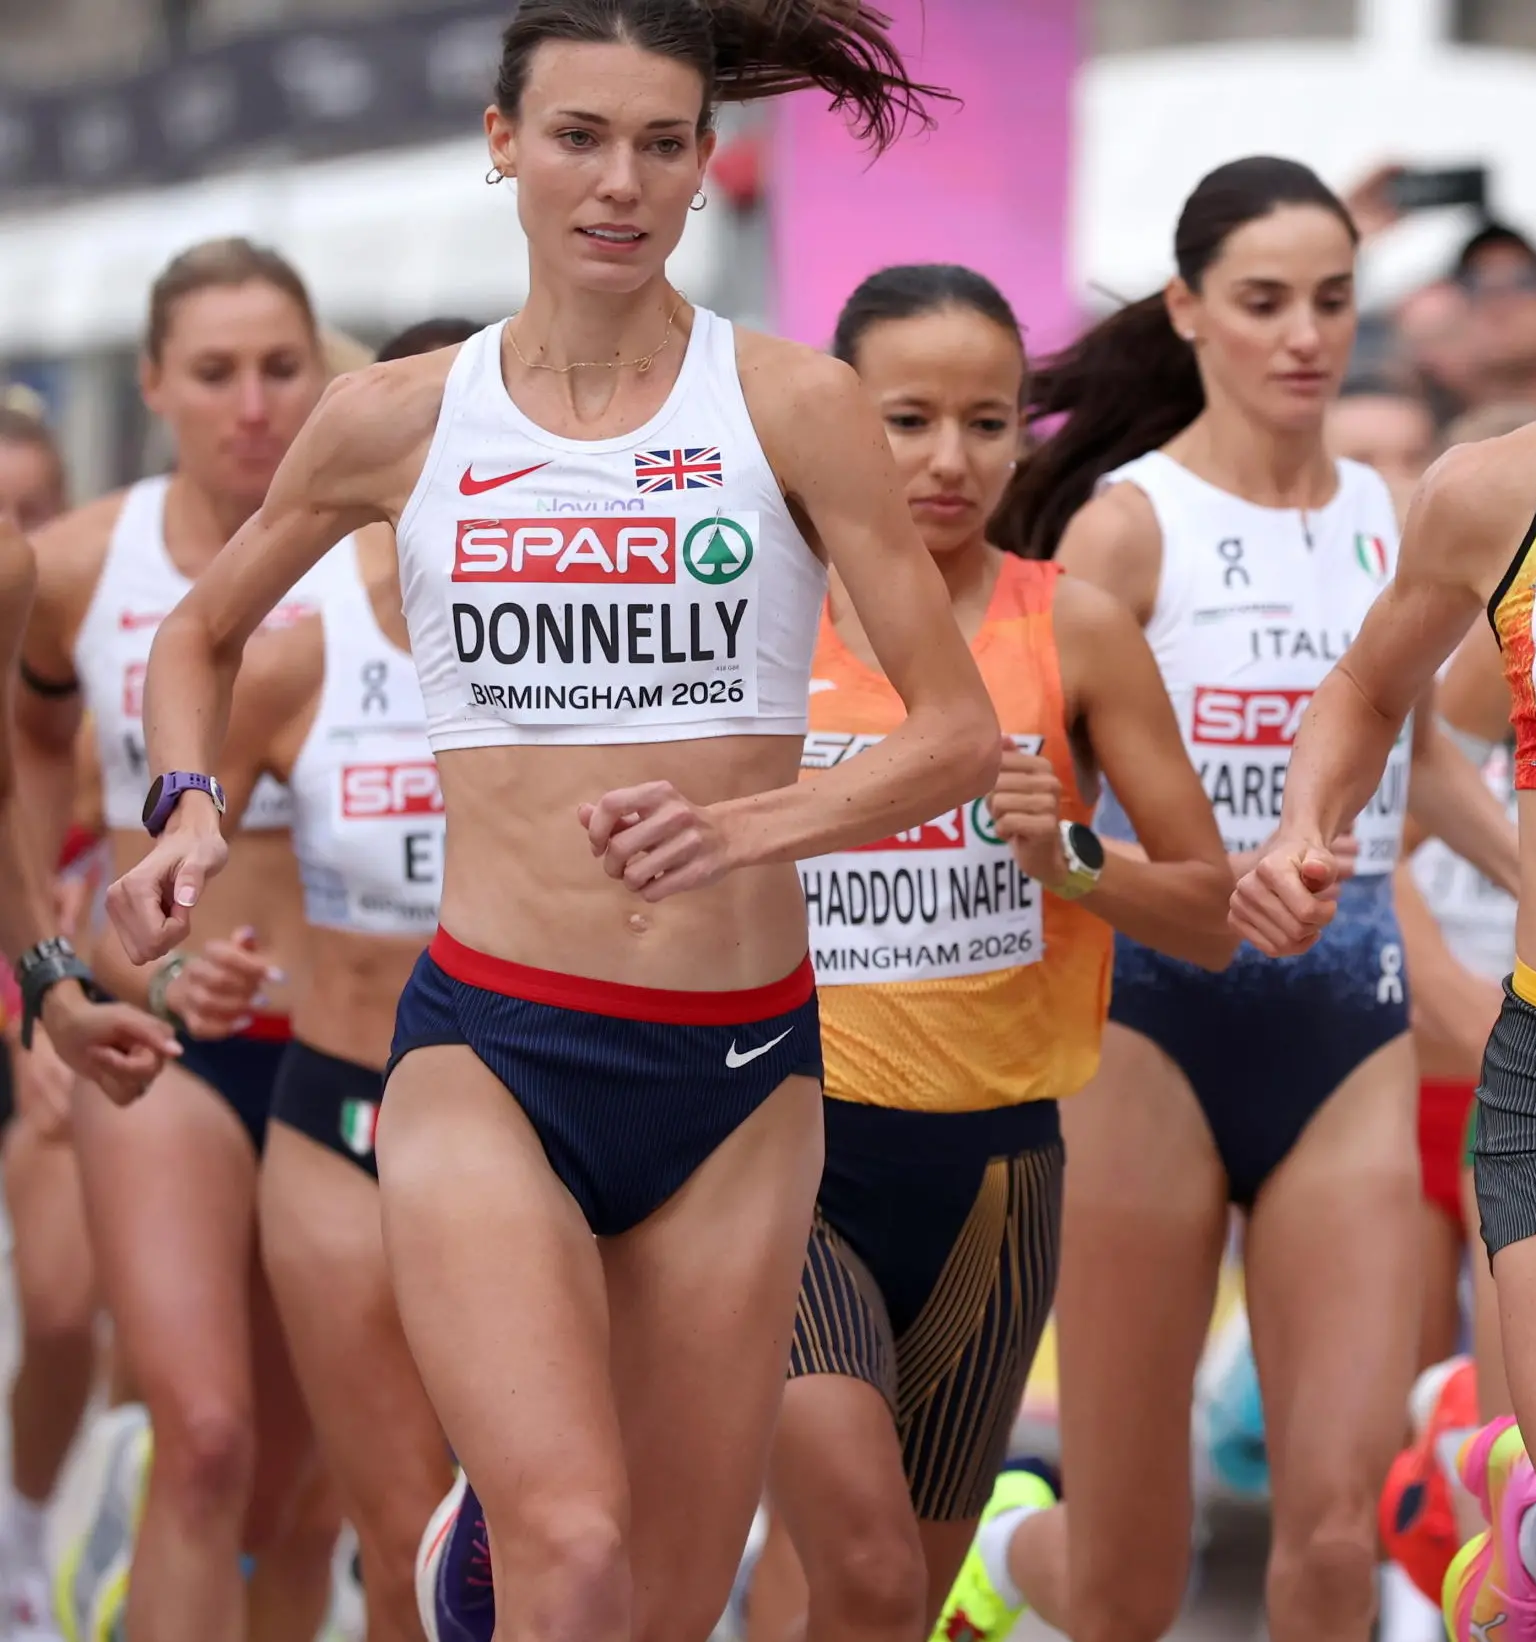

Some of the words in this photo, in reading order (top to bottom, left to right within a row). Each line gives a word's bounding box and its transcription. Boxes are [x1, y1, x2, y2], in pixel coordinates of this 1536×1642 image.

[461, 527, 670, 574] SPAR
[452, 599, 748, 664] DONNELLY
[1252, 628, 1350, 661] ITAL
[471, 682, 663, 709] BIRMINGHAM
[671, 678, 744, 706] 2026
[1196, 694, 1312, 740] SP
[347, 767, 444, 812] SP
[803, 867, 938, 927] HADDOU
[949, 860, 1033, 921] NAFIE
[815, 943, 960, 971] MINGHAM
[968, 929, 1034, 962] 2026
